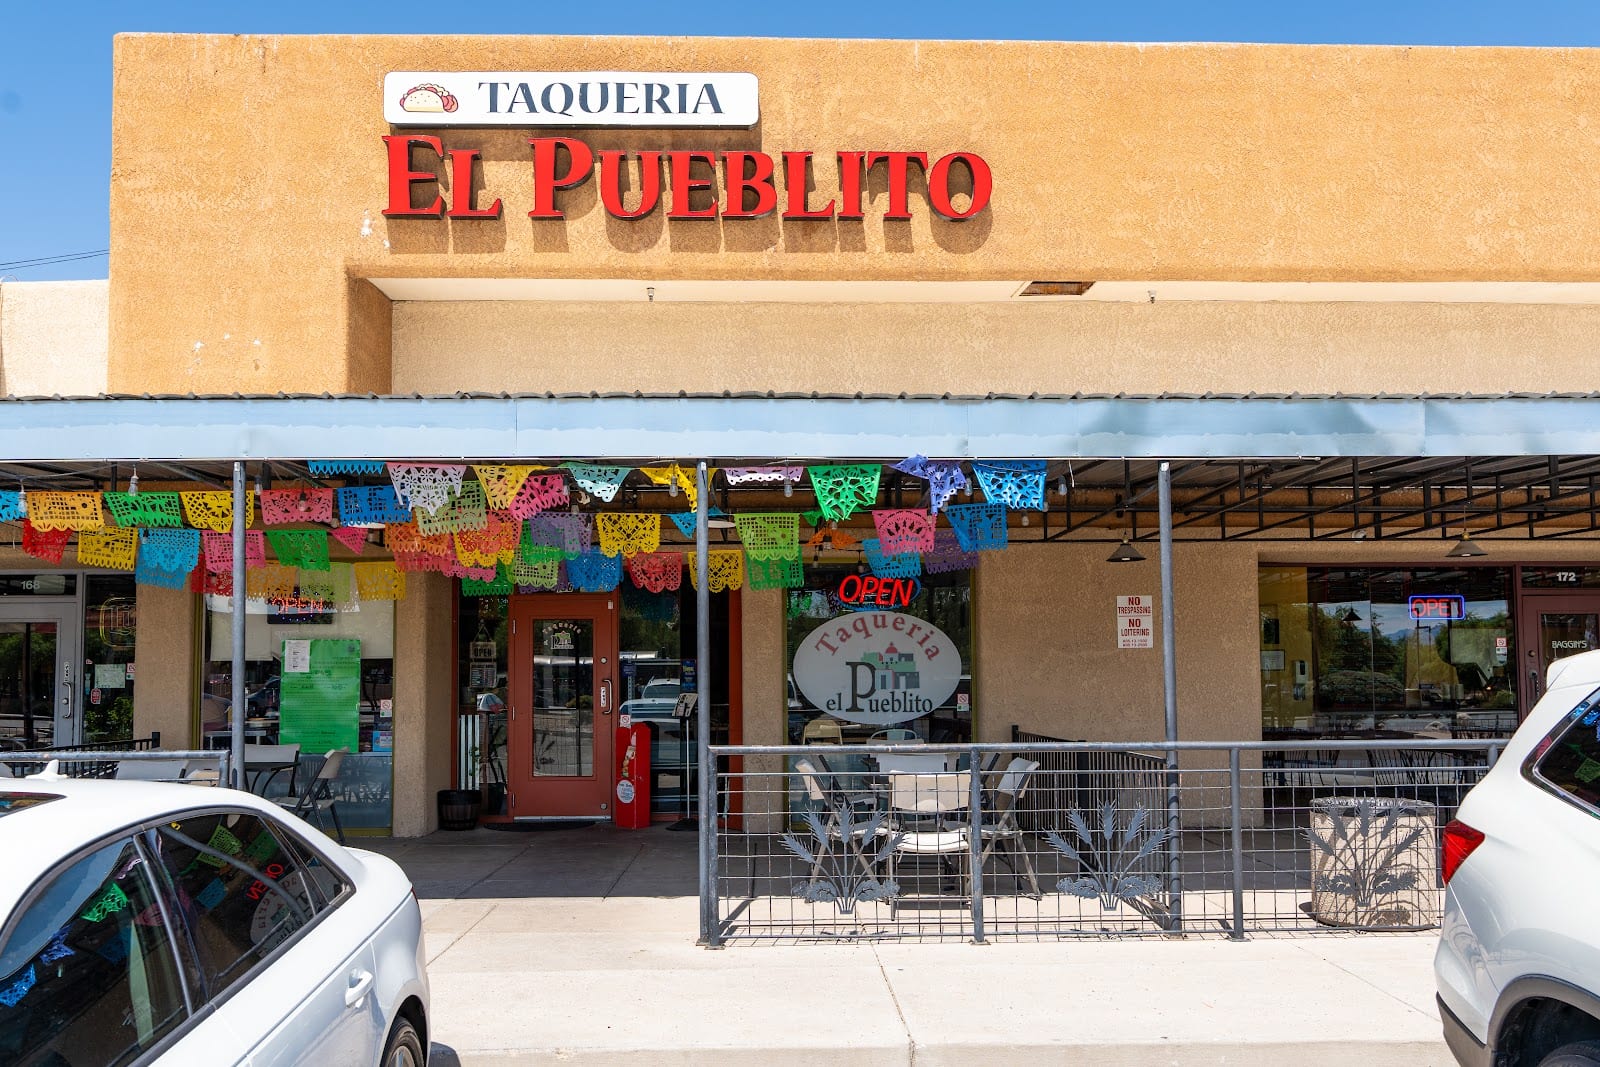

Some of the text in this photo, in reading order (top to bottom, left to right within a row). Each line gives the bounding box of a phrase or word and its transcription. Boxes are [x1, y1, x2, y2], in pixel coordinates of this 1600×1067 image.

[478, 82, 726, 118] TAQUERIA
[381, 135, 993, 220] EL PUEBLITO
[1556, 572, 1577, 582] 172
[21, 580, 41, 590] 168
[838, 575, 914, 607] OPEN
[1128, 596, 1140, 606] NO
[1117, 606, 1151, 614] TRESPASSING
[1128, 618, 1141, 627] NO
[815, 614, 940, 661] Taqueria
[1120, 629, 1150, 637] LOITERING
[1551, 640, 1588, 649] BAGGIN'S
[826, 661, 933, 713] el Pueblito
